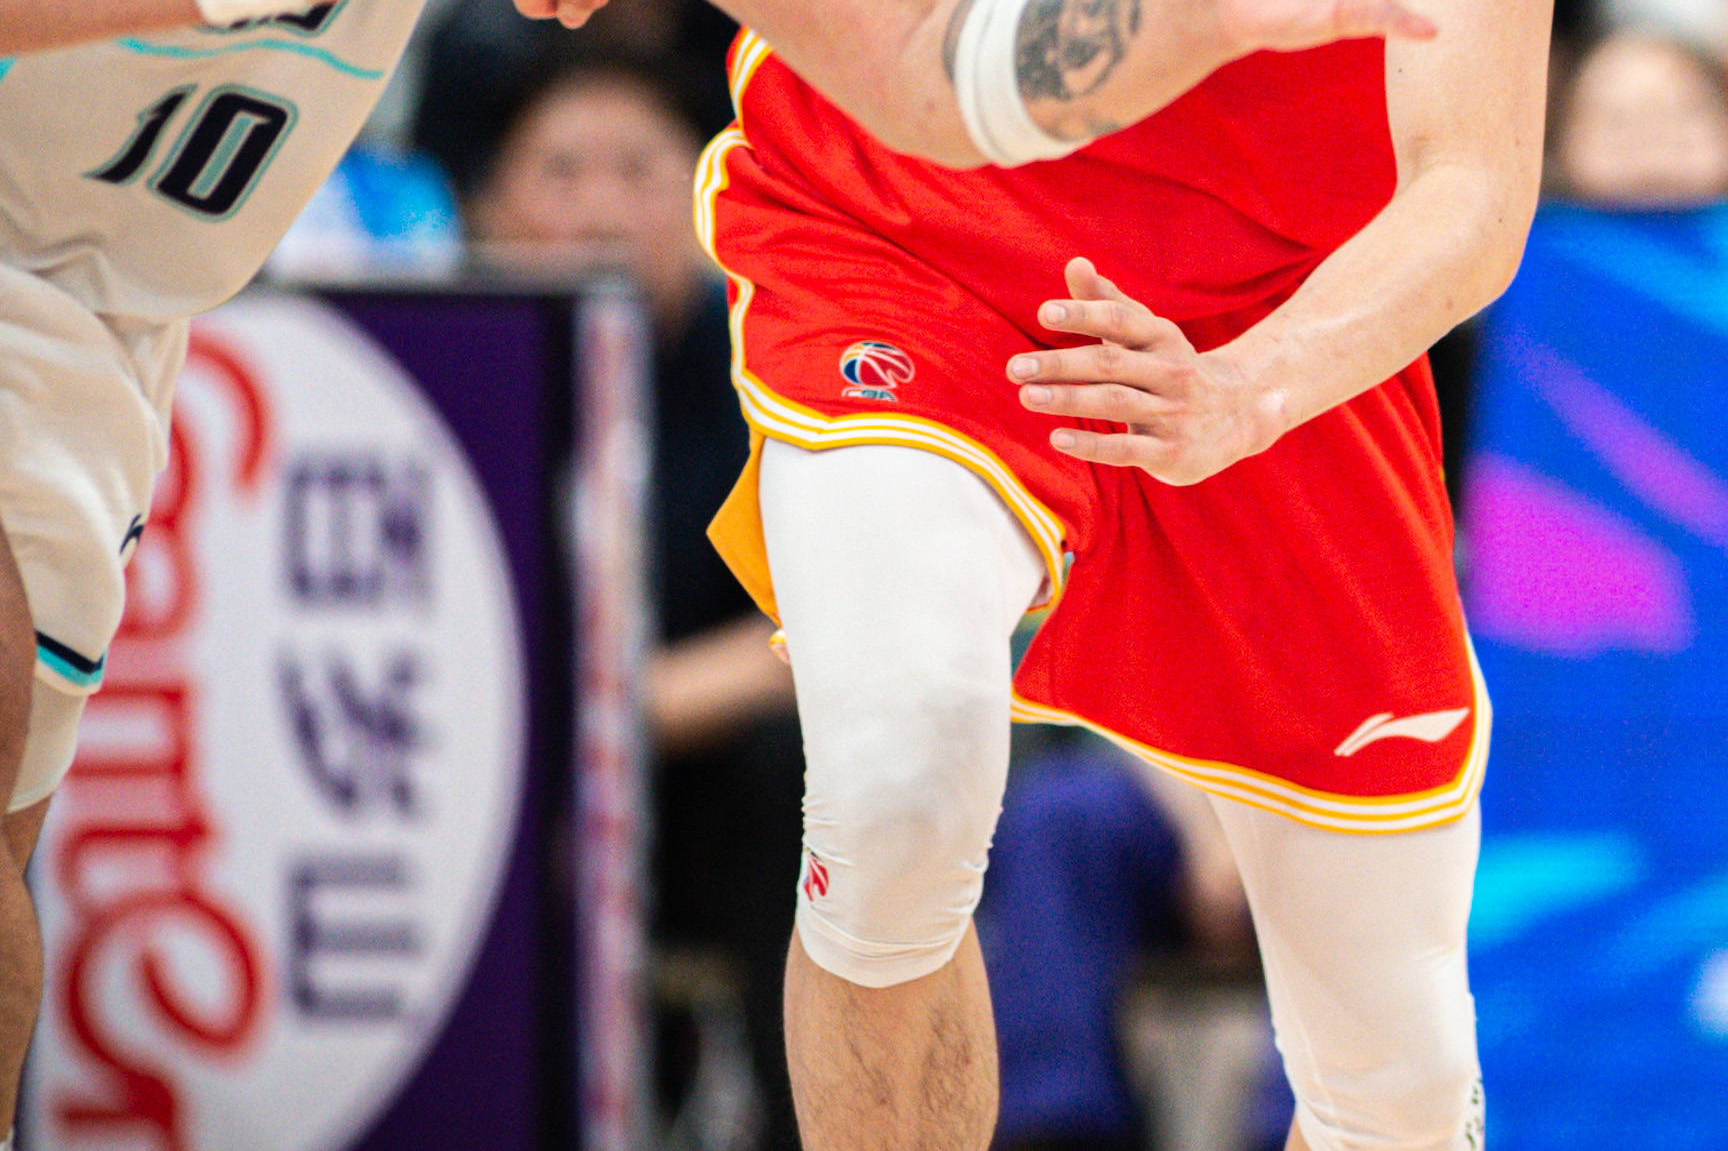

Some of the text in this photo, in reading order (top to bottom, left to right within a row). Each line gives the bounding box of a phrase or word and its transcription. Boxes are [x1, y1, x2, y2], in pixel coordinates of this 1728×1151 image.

[82, 81, 299, 223] 10
[281, 455, 432, 1022] 百岁山
